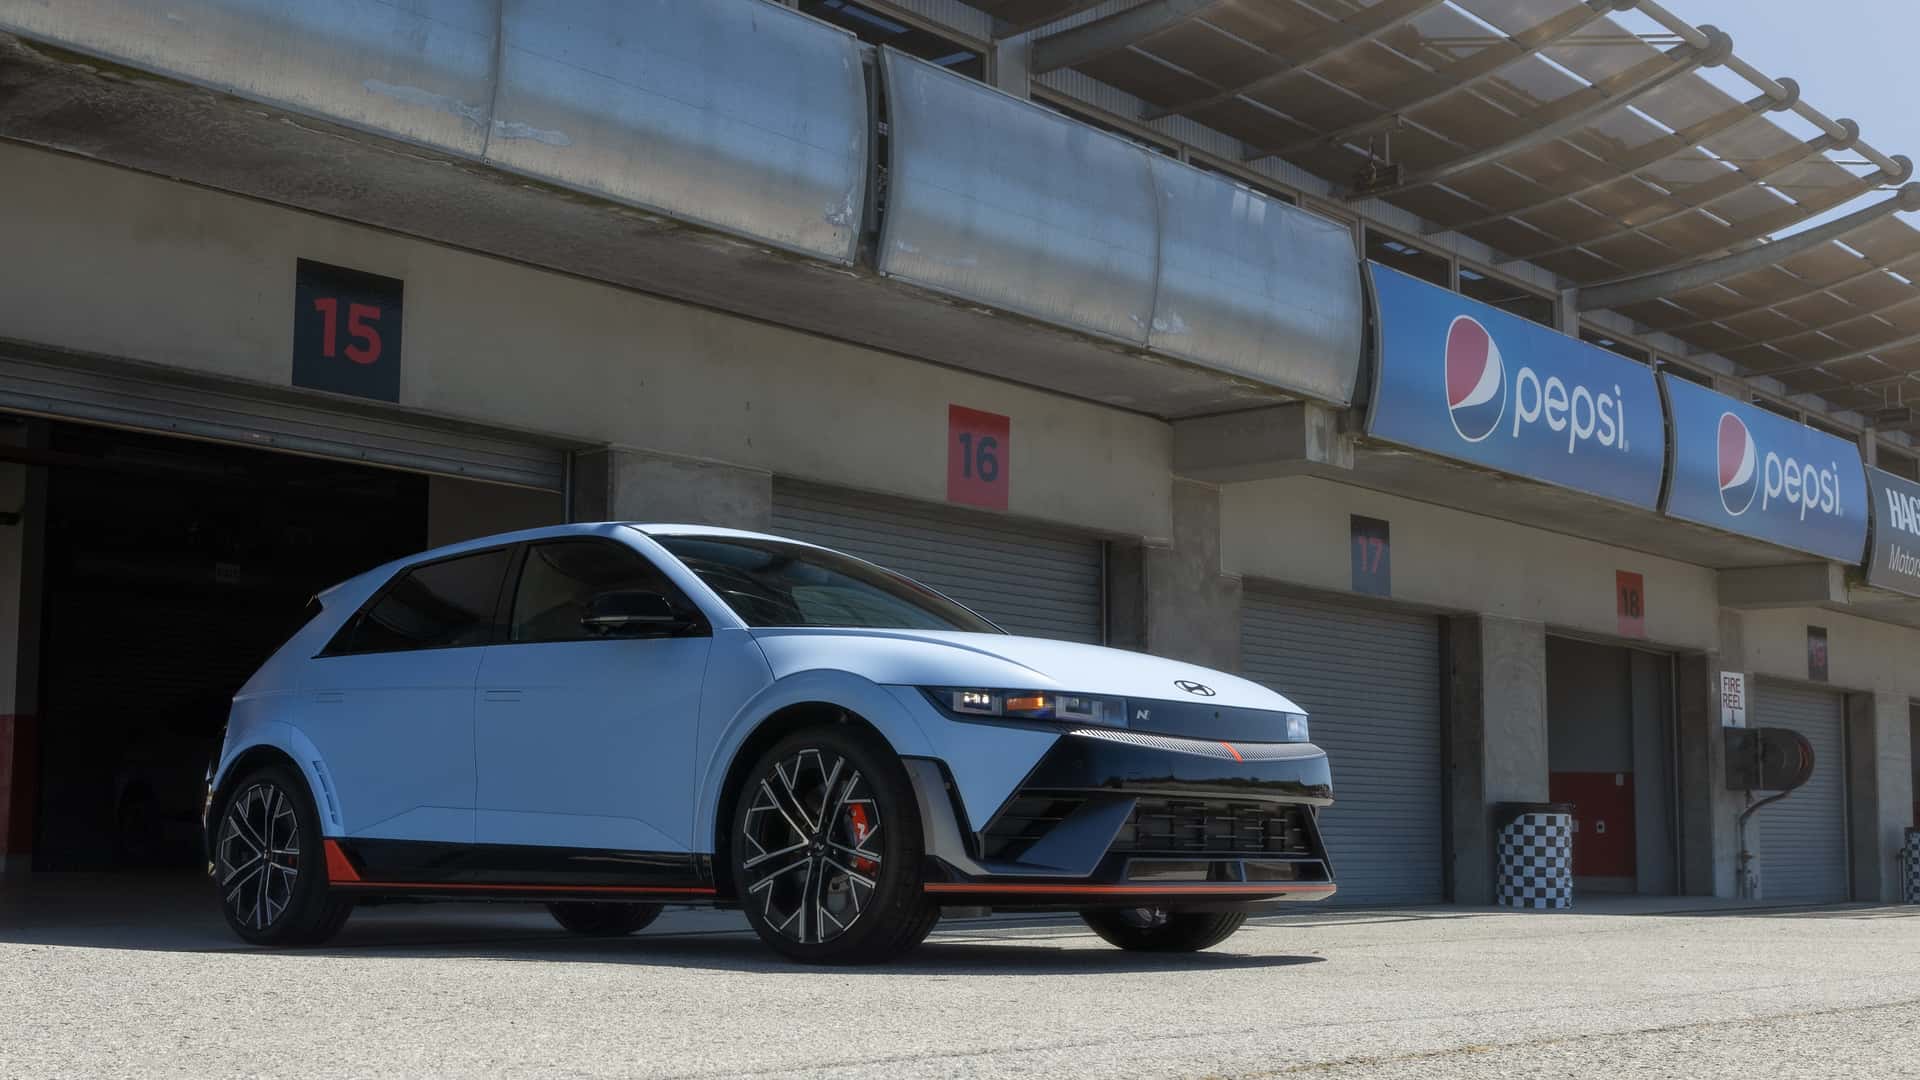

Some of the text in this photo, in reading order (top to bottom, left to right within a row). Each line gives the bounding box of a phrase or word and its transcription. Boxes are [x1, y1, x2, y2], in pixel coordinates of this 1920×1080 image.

[314, 297, 382, 364] 15
[1513, 366, 1624, 454] pepsi
[959, 433, 999, 482] 16
[1762, 451, 1840, 521] pepsi
[1359, 536, 1385, 576] 17
[1622, 588, 1640, 619] 18
[1722, 693, 1743, 710] REEL
[1723, 676, 1742, 693] FIRE
